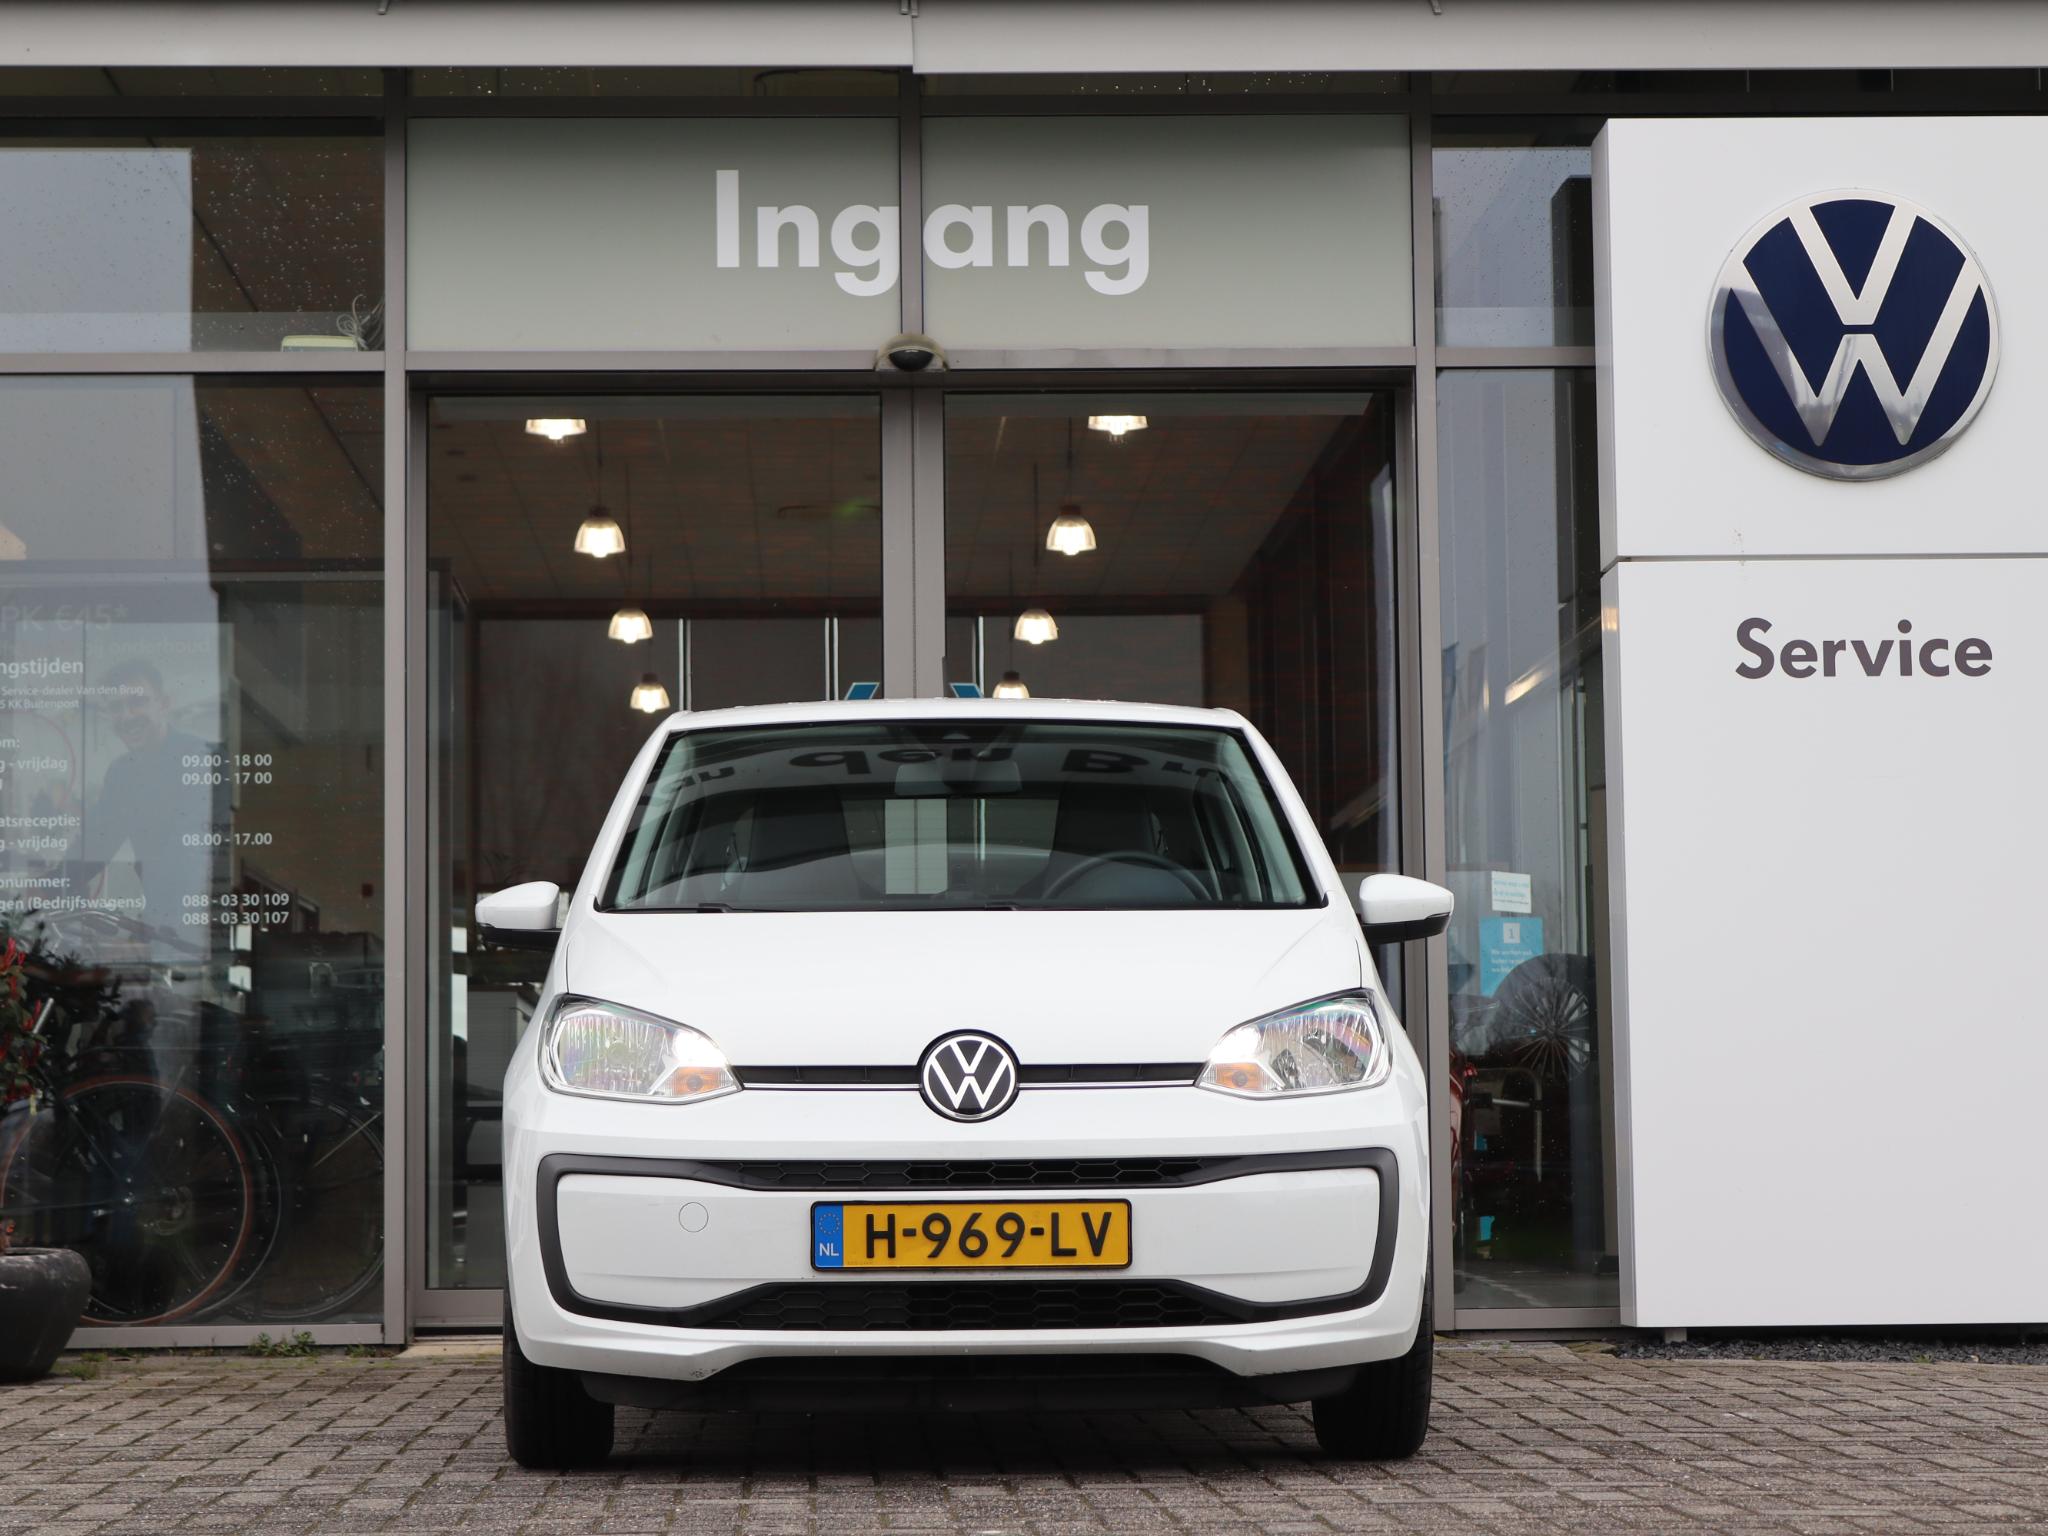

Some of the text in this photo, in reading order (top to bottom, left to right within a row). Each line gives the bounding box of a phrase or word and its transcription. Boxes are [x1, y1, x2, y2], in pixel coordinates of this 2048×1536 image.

[716, 170, 1150, 297] Ingang
[1735, 617, 1993, 680] Service
[17, 755, 68, 773] vrijdag
[182, 754, 222, 768] 09.00
[182, 772, 222, 785] 09.00
[17, 835, 68, 852] vrijdag
[182, 833, 222, 846] 08.00
[233, 832, 273, 846] 17.00
[28, 895, 147, 912] (Bedrijfswagens)
[182, 894, 209, 907] 088
[221, 893, 239, 907] 03
[241, 893, 260, 907] 30
[264, 892, 290, 906] 109
[182, 912, 209, 925] 088
[221, 911, 239, 925] 03
[241, 911, 260, 925] 30
[264, 911, 290, 925] 107
[866, 1211, 1112, 1258] H-969-LV
[819, 1243, 839, 1257] NL
